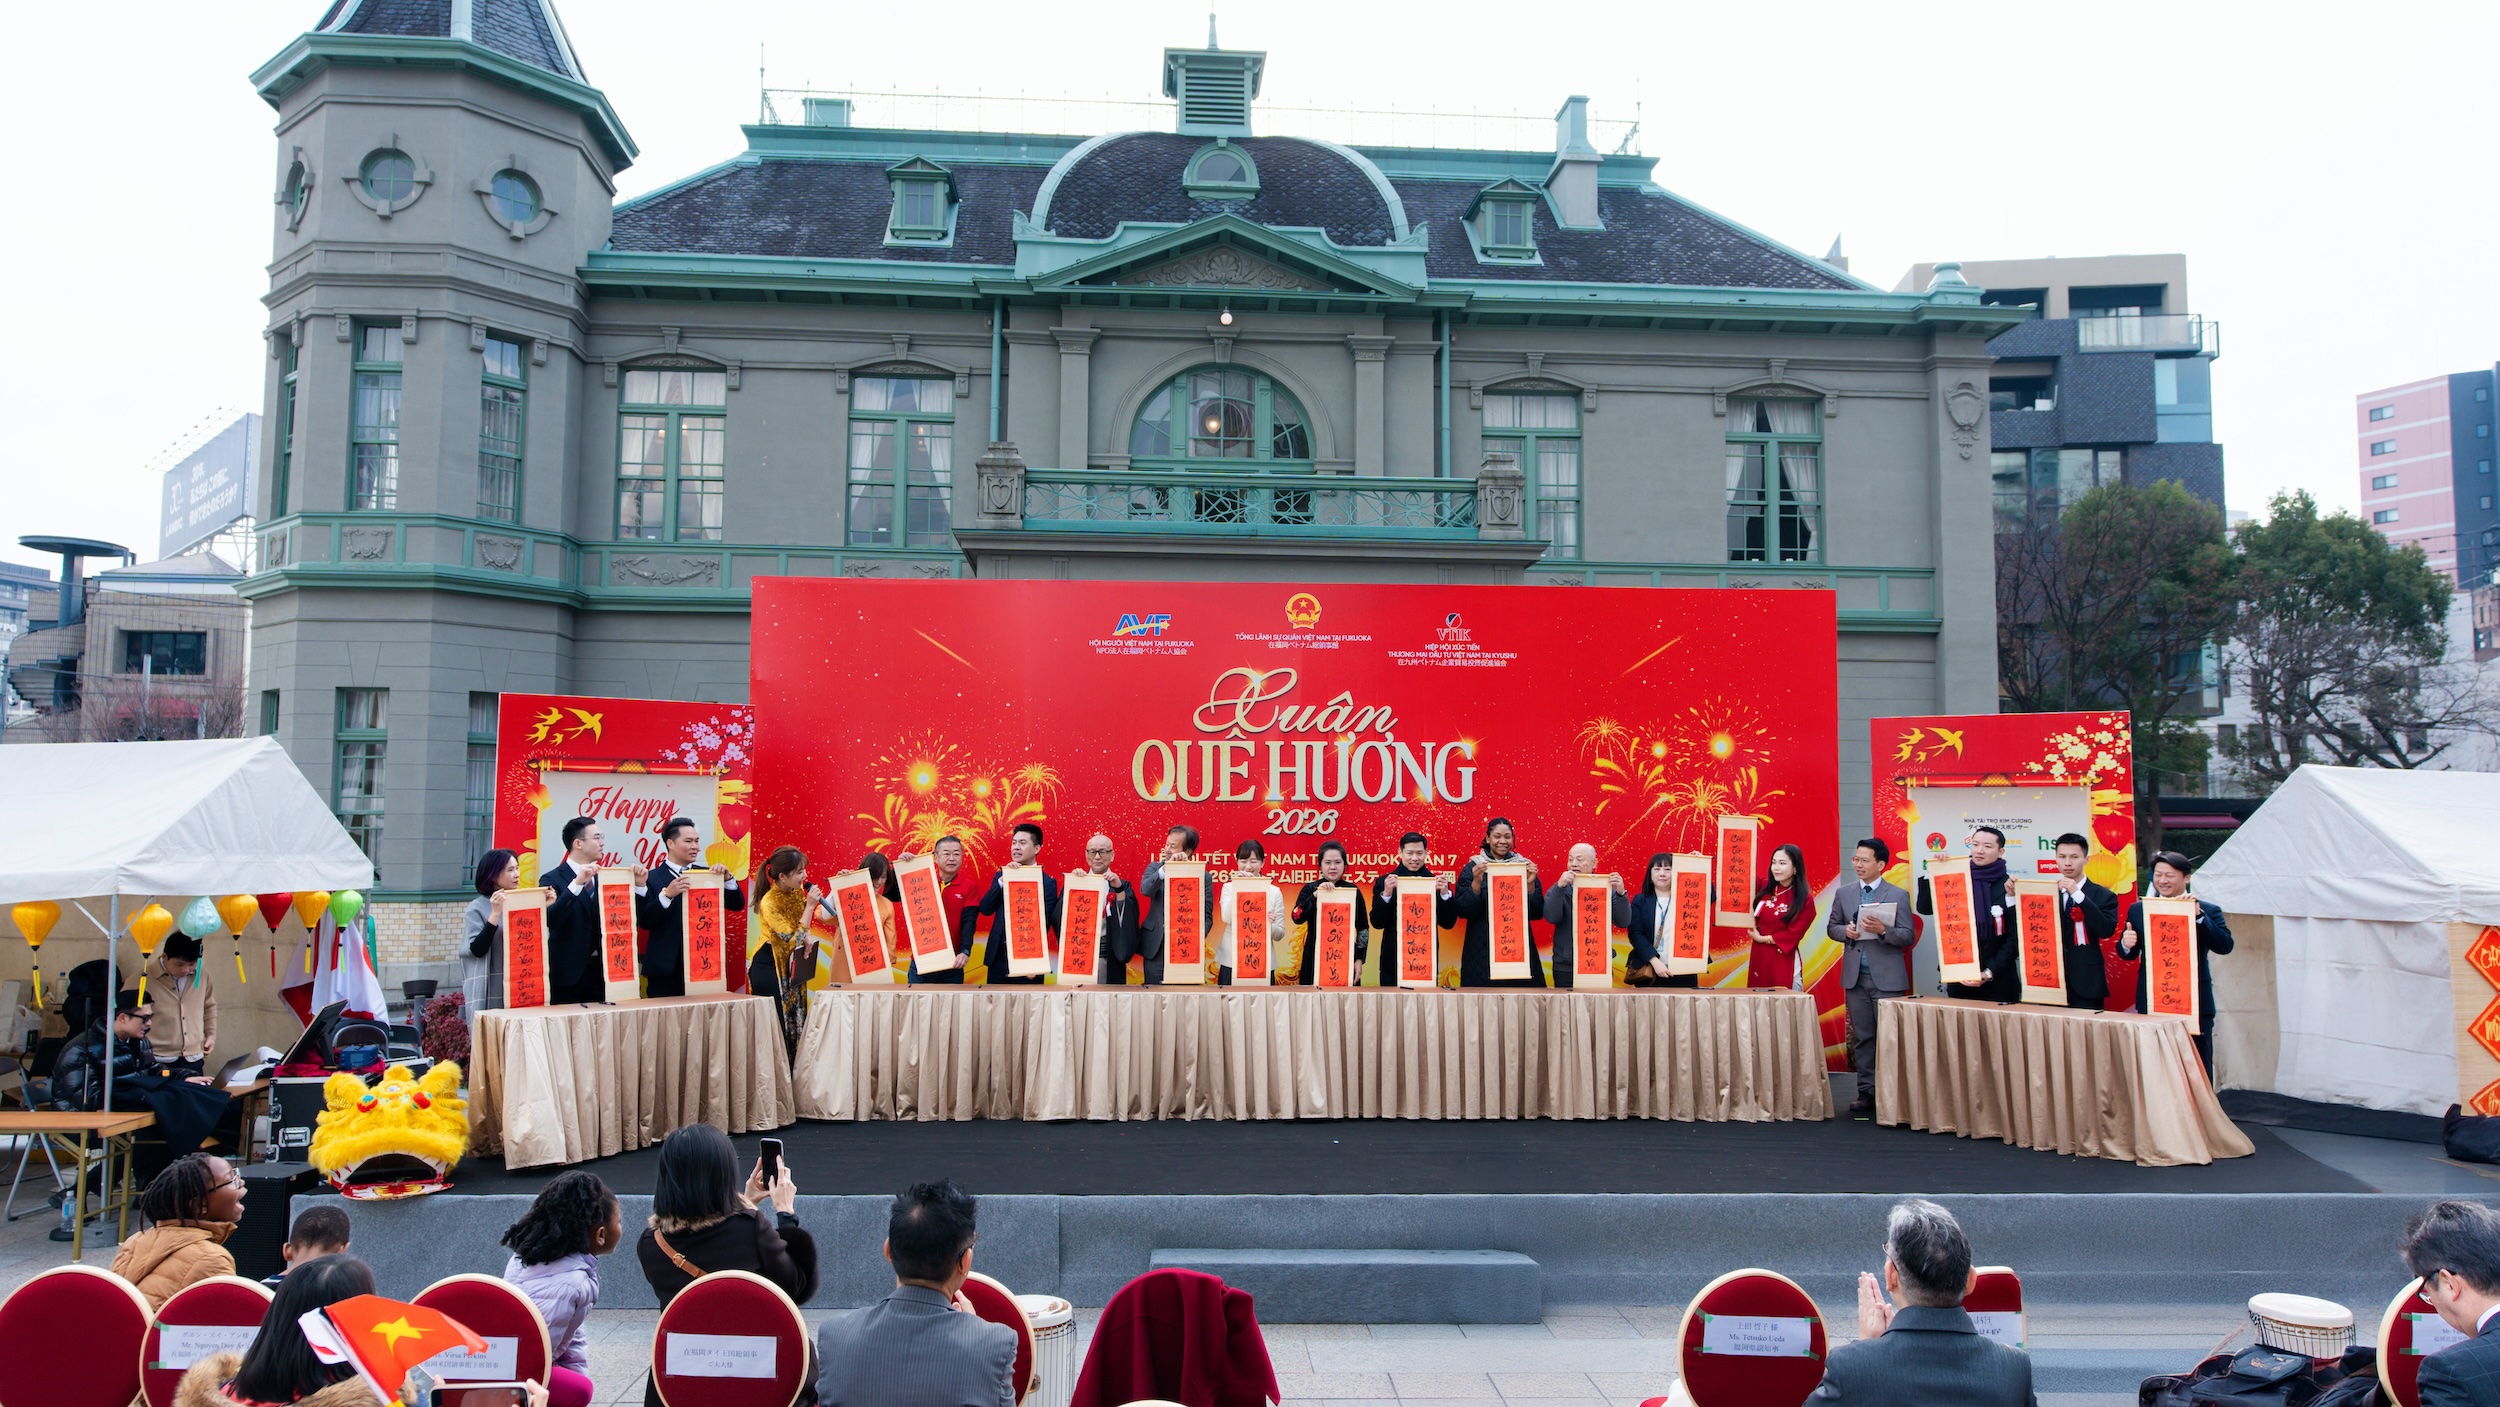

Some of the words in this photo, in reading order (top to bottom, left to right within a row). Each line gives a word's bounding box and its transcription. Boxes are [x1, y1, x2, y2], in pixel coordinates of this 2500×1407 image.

[1113, 613, 1171, 636] AVF
[1235, 632, 1254, 640] TỔNG
[1193, 667, 1398, 734] Xuân
[1131, 728, 1256, 803] QUÊ
[1267, 731, 1477, 804] HƯƠNG
[578, 786, 680, 834] Happy
[1262, 808, 1339, 836] 2026
[1203, 849, 1230, 865] TẾT
[1270, 853, 1305, 865] NAM
[1447, 854, 1457, 866] 7
[684, 1348, 757, 1358] 在福岡タイ王国総領事
